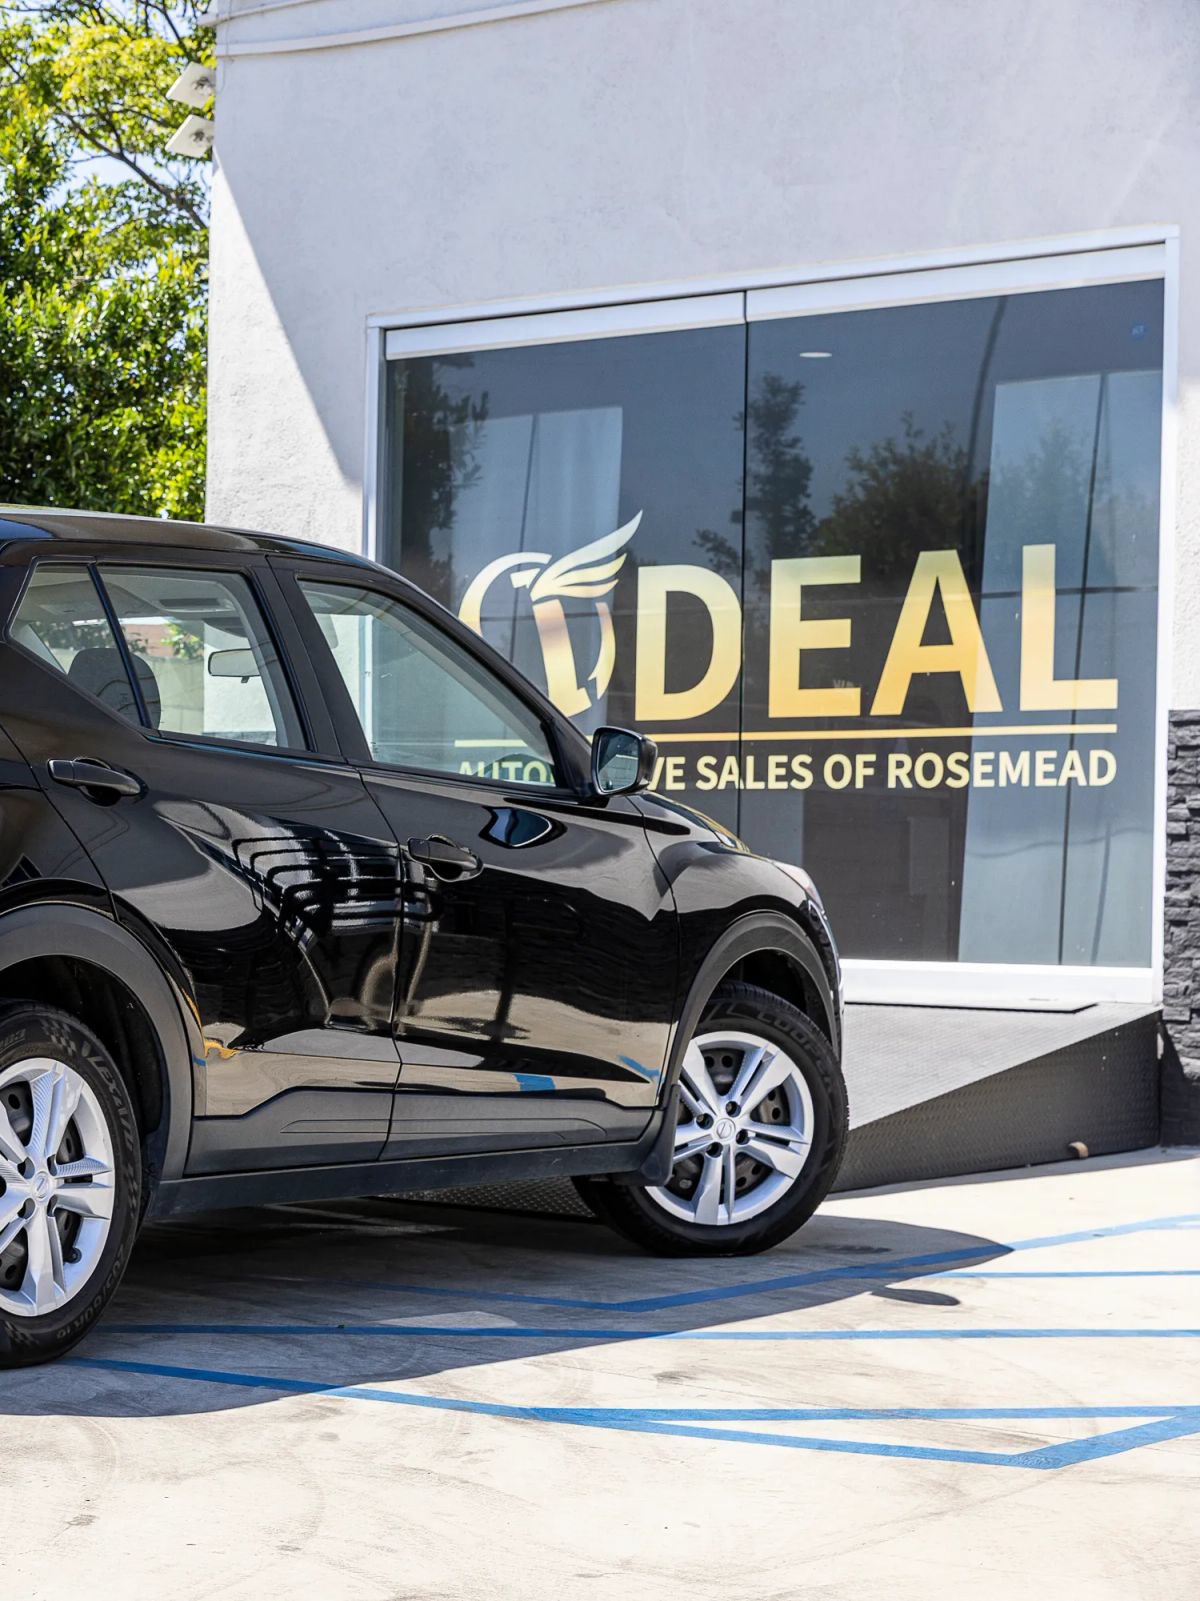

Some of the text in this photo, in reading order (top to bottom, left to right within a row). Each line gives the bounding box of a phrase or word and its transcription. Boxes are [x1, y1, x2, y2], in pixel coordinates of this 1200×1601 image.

[695, 754, 813, 791] SALES
[823, 753, 877, 790] OF
[887, 749, 1118, 789] ROSEMEAD
